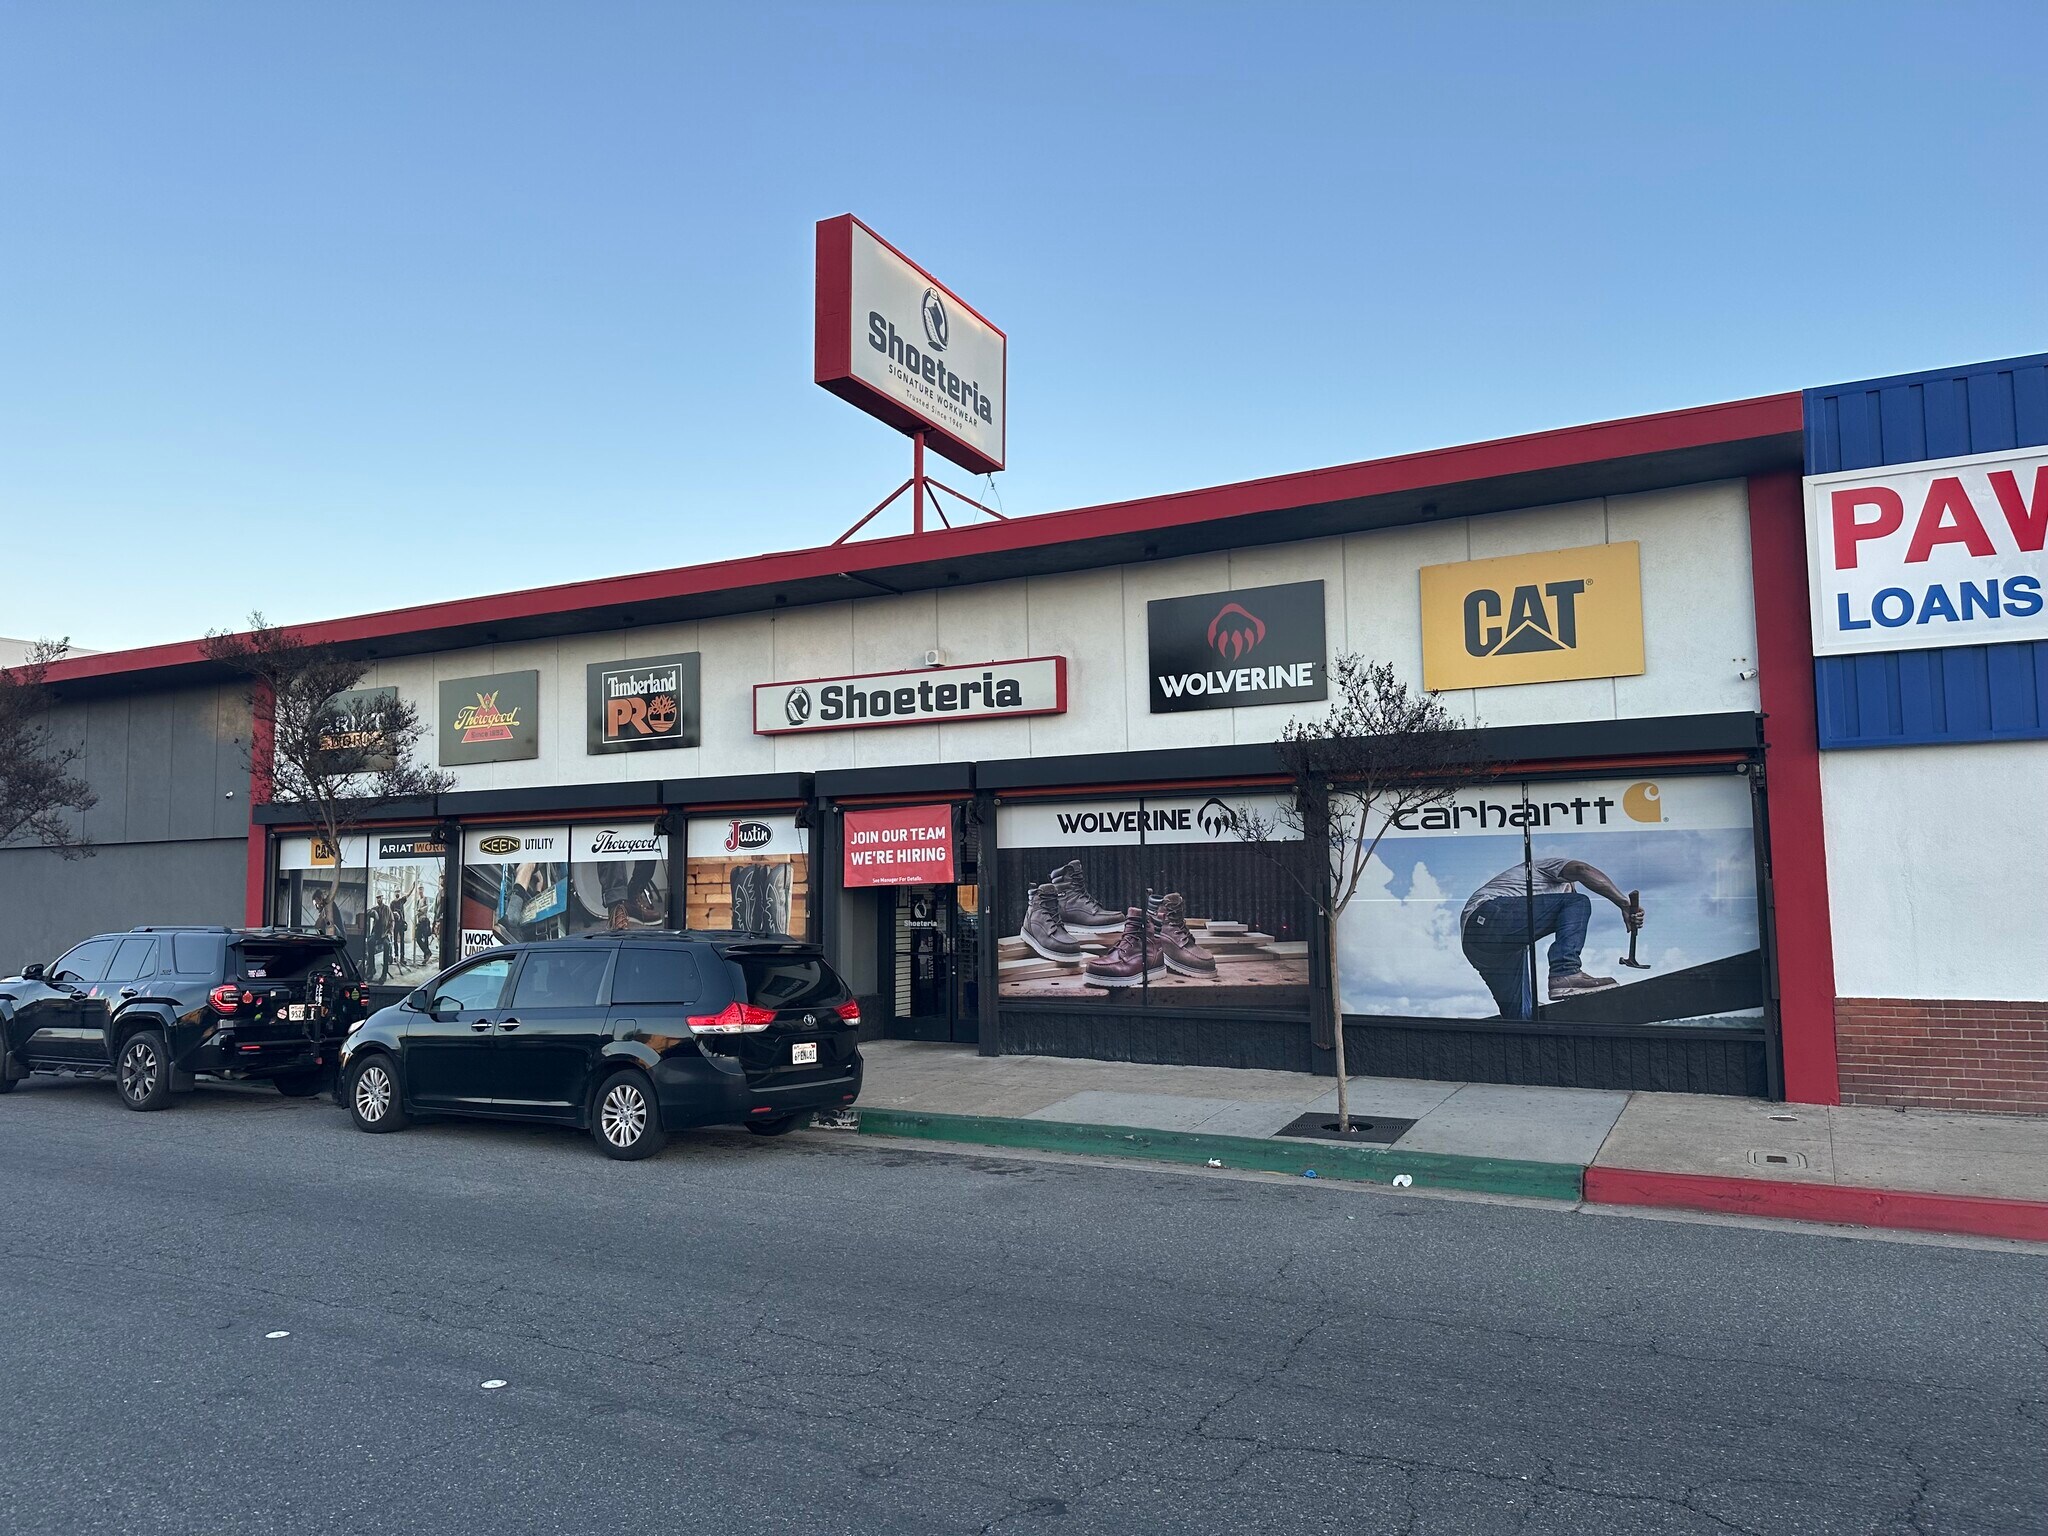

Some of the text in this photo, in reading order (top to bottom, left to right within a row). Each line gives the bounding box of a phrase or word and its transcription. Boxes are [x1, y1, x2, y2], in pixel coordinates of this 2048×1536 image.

[868, 310, 993, 426] Shoeteria
[888, 364, 978, 428] SIGNATURE WORKWEAR
[906, 389, 963, 430] Trusted Since 1949
[1837, 575, 2044, 631] LOANS
[1463, 579, 1585, 657] CAT
[607, 670, 677, 697] Timberland
[1158, 662, 1314, 698] WOLVERINE
[820, 671, 1023, 721] Shoeteria
[454, 705, 520, 731] Thorogood
[1056, 808, 1192, 835] WOLVERINE
[1394, 796, 1614, 831] carhartt
[381, 844, 413, 853] ARIAT
[480, 838, 554, 852] KEEN UTILITY
[591, 830, 662, 854] Thorogood
[725, 821, 769, 850] Justin
[850, 826, 946, 845] JOIN OUR TEAM
[850, 846, 946, 866] WE'RE HIRING
[903, 919, 938, 927] Shoeteria
[465, 933, 494, 945] WORK
